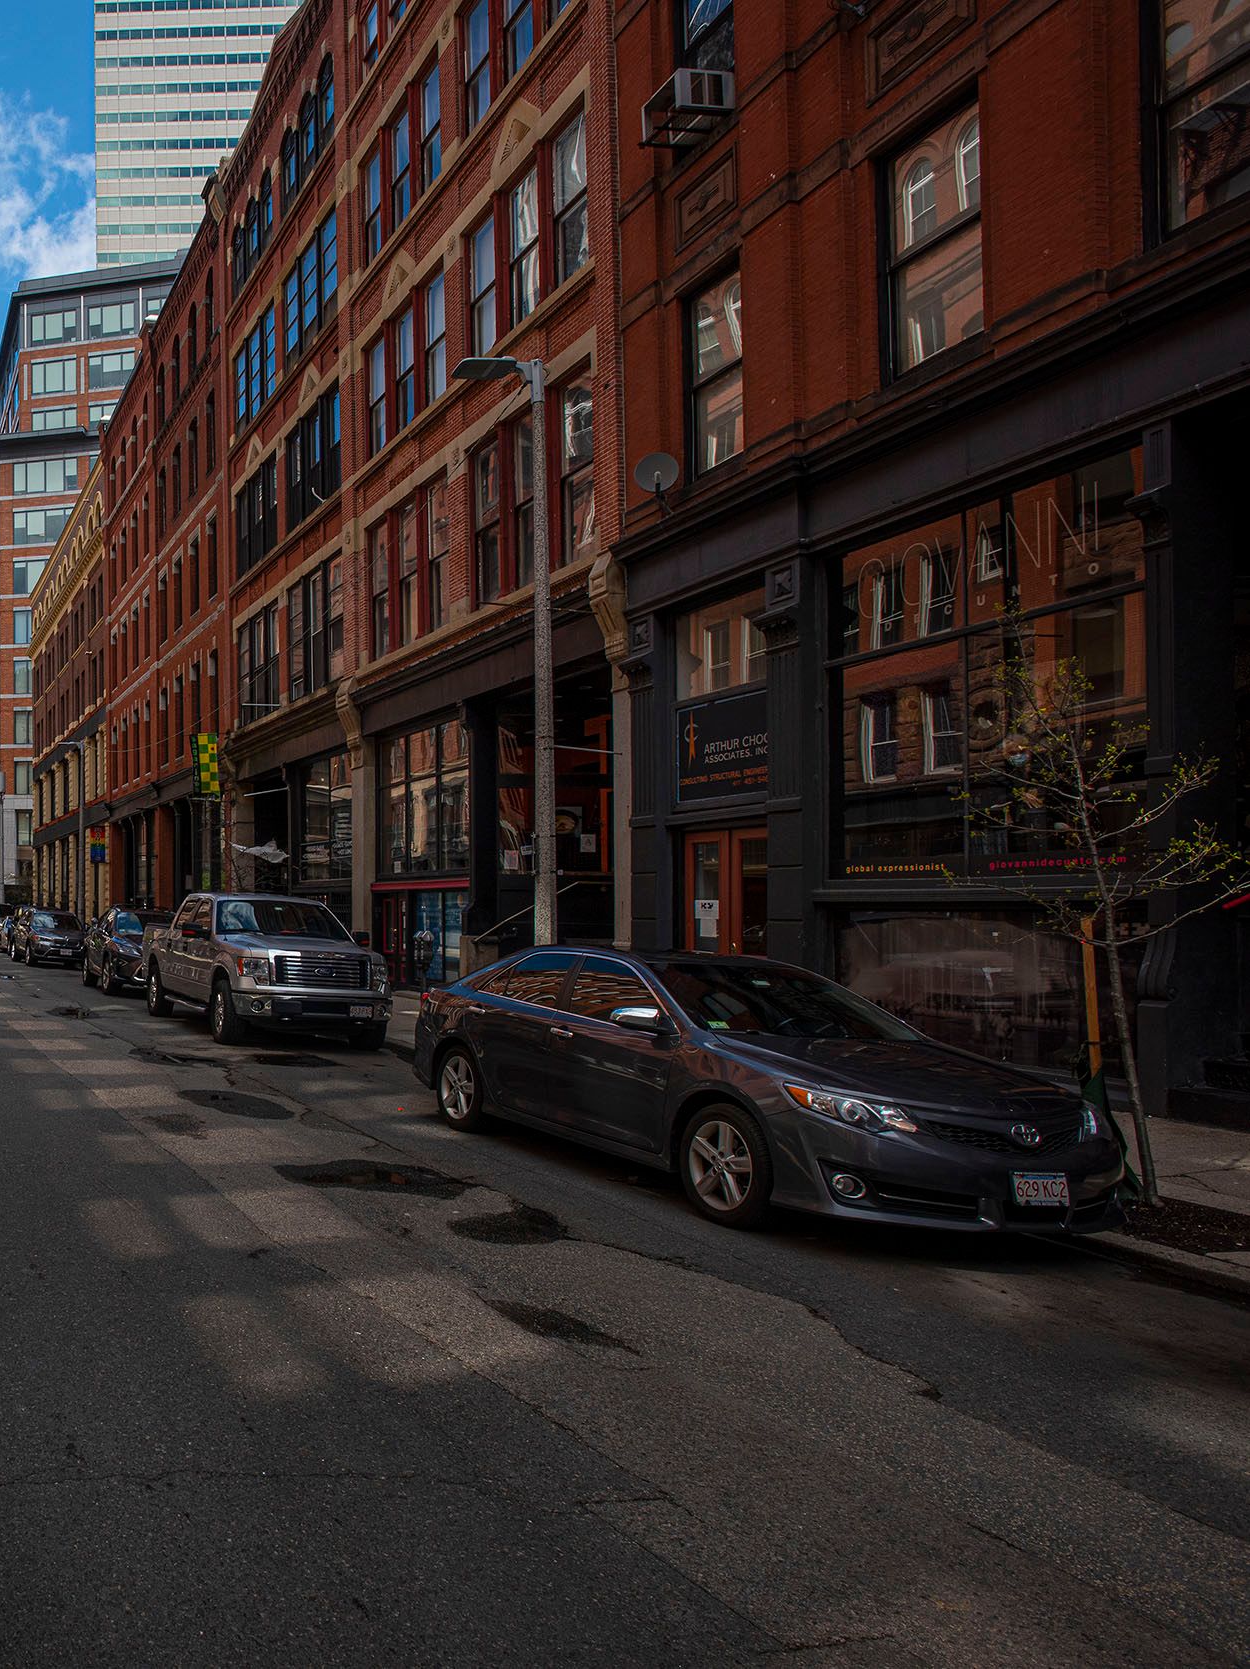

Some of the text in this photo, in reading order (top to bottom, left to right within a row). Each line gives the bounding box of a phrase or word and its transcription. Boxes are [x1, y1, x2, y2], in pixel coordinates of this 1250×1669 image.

[858, 480, 1098, 619] GIOVANNI
[704, 737, 739, 754] ARTHUR
[710, 769, 741, 782] STRUCTURAL
[845, 863, 946, 874] global expressionist
[1016, 1180, 1068, 1198] 629 KC2
